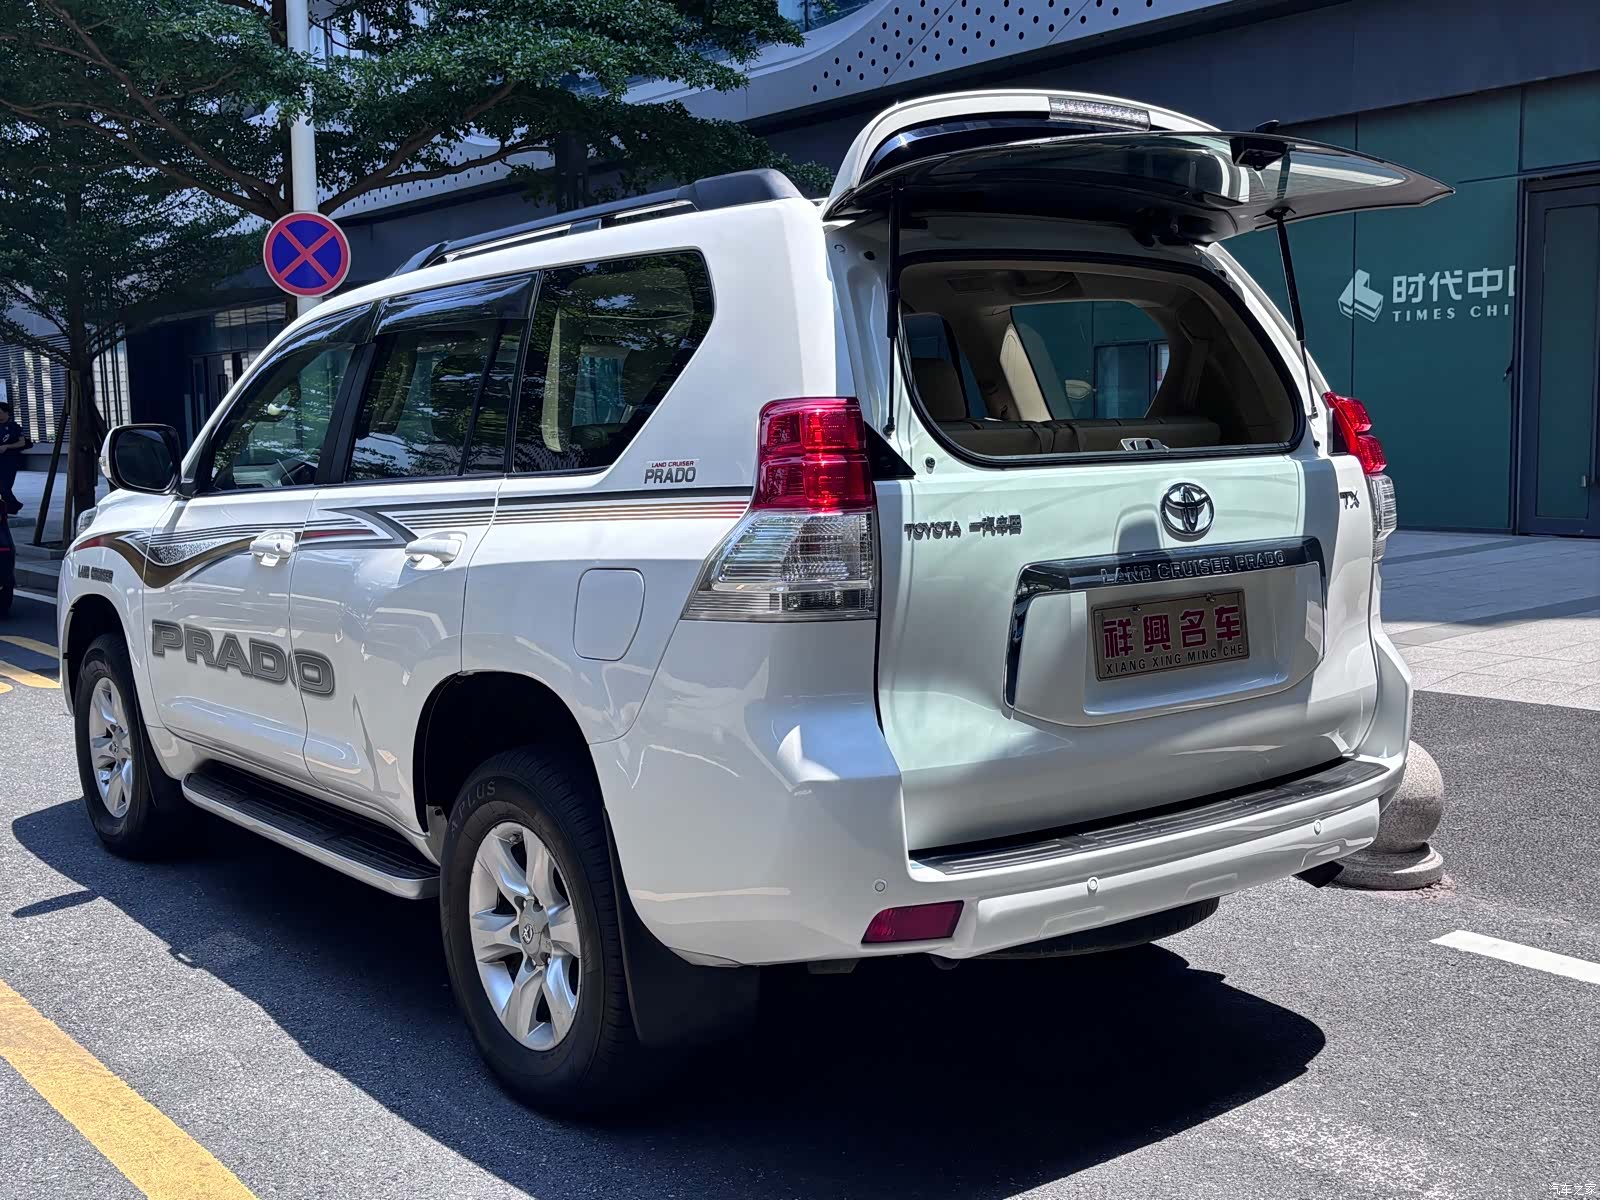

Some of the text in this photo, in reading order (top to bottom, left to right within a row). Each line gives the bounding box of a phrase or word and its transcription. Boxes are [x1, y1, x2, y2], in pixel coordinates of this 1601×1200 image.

[1392, 265, 1516, 303] 时代中
[1392, 307, 1456, 322] TIMES
[644, 467, 697, 484] PRADO
[1339, 490, 1360, 510] TX
[903, 521, 961, 540] TOYOTA
[1100, 550, 1286, 585] LAND CRUISER PRADO
[1103, 605, 1242, 659] 祥興名车
[152, 619, 335, 696] PRADO
[1106, 644, 1244, 675] XIANG XING MING CHE
